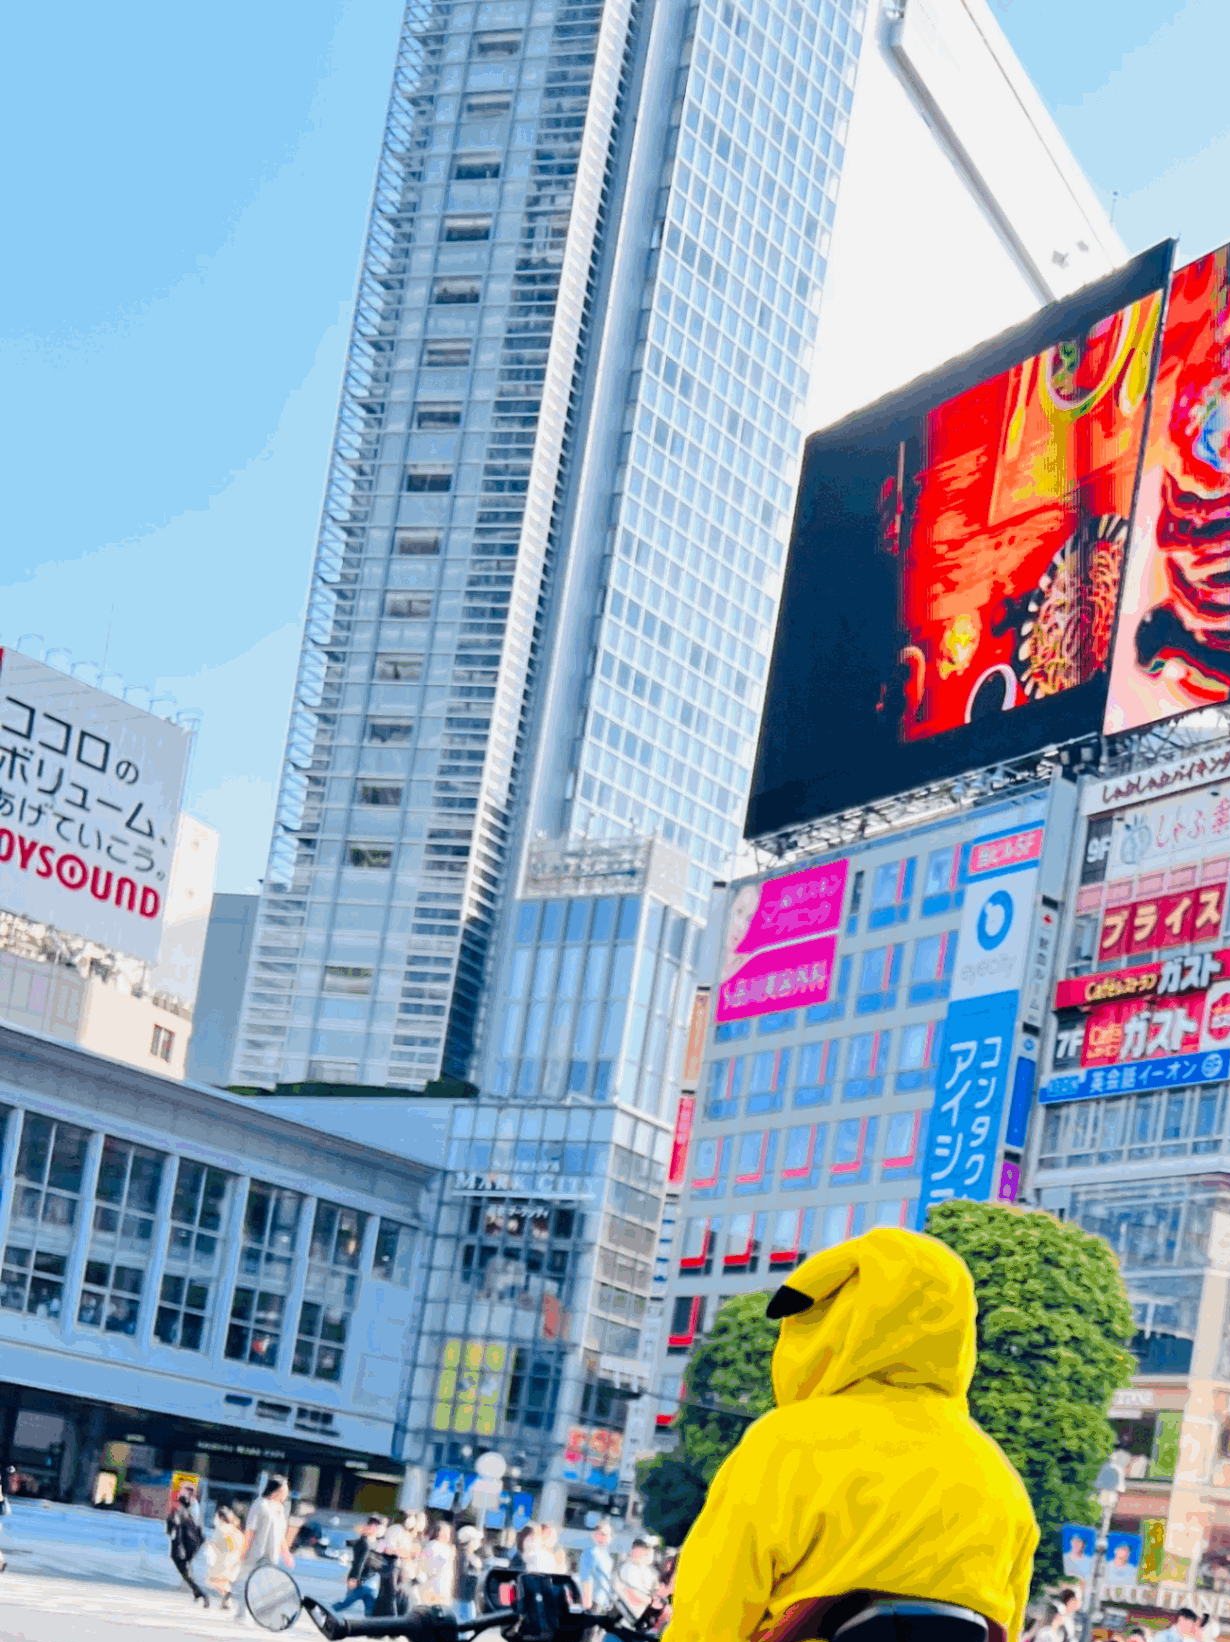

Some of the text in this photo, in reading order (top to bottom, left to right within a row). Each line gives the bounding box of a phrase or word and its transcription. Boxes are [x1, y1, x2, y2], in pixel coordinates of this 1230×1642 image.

[1, 695, 140, 785] ココロの
[1101, 889, 1222, 948] プライス
[1056, 1029, 1085, 1059] 7F
[1119, 1010, 1198, 1060] ガスト
[963, 1036, 1002, 1198] コンタク
